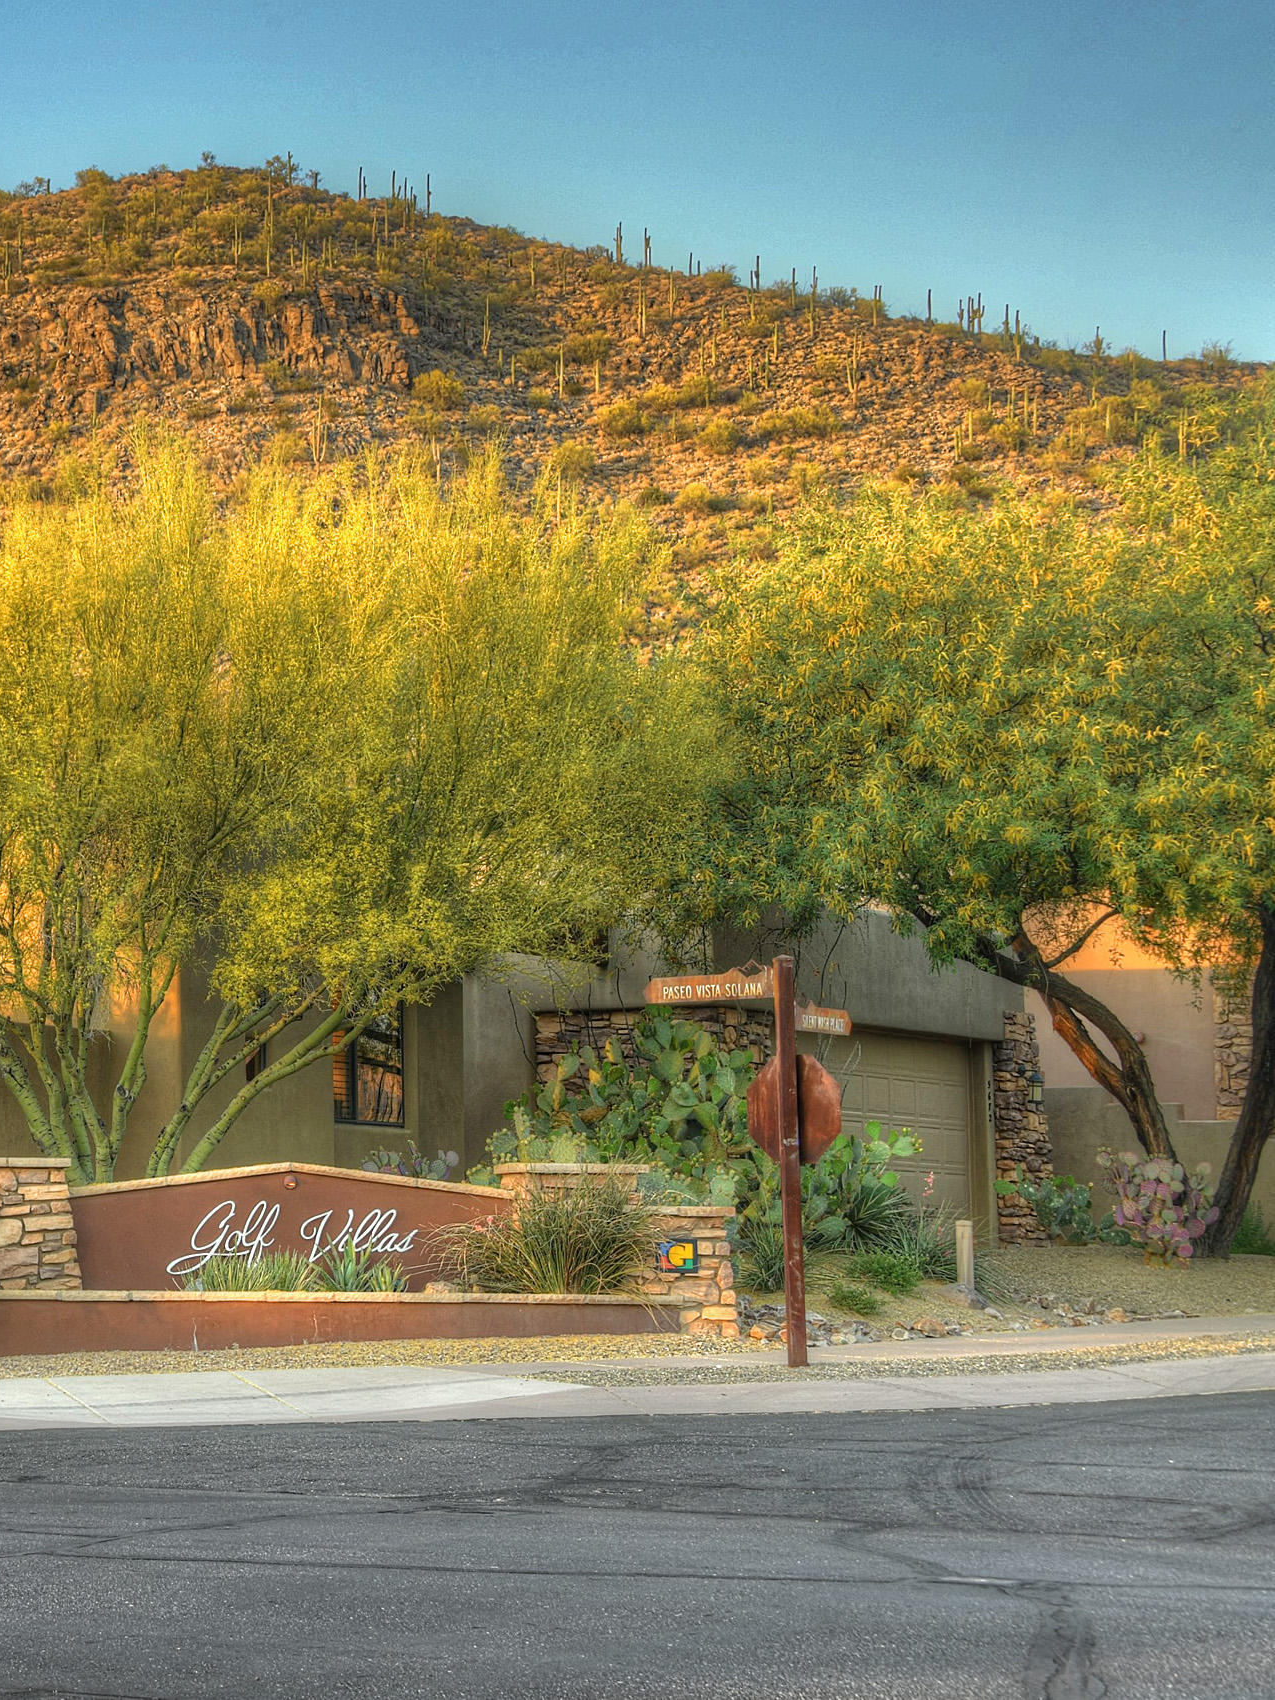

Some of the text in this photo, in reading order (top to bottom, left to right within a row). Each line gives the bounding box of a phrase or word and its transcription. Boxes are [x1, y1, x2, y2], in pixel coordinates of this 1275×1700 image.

[662, 983, 763, 1000] PASEO VISTA SOLANA
[165, 1199, 419, 1276] Golf Villas
